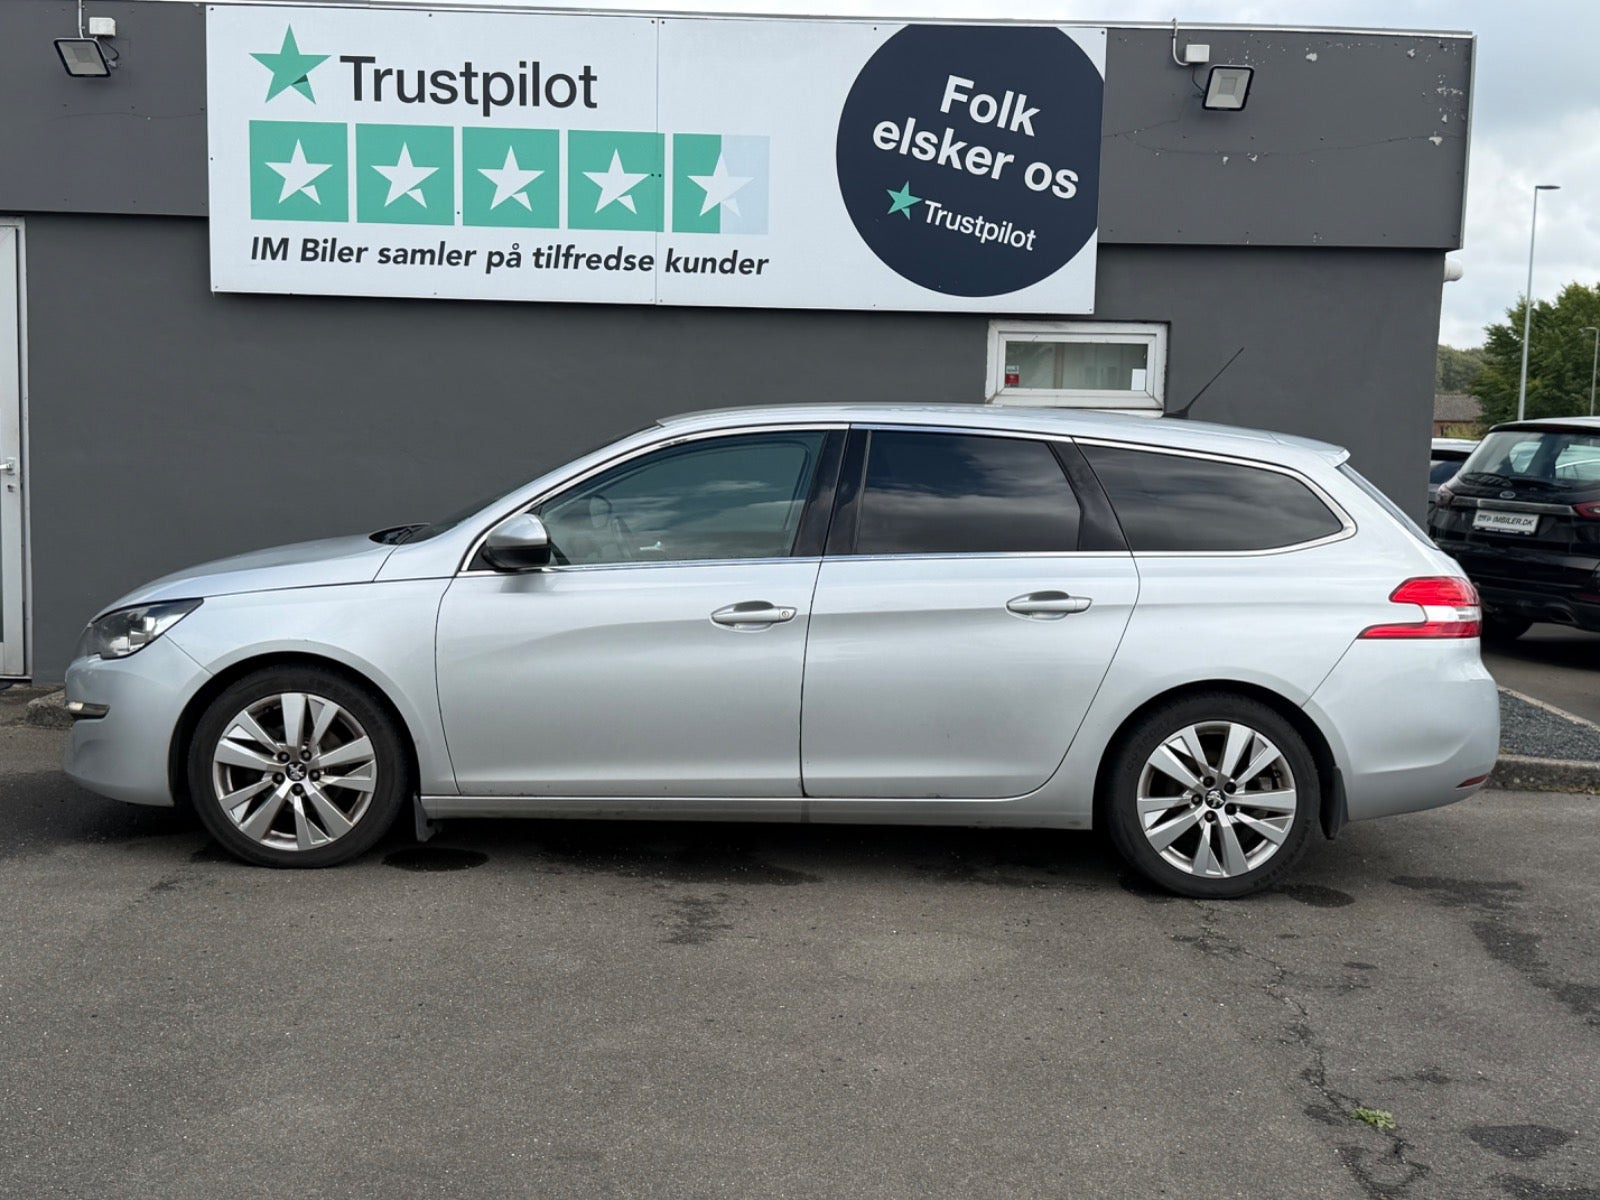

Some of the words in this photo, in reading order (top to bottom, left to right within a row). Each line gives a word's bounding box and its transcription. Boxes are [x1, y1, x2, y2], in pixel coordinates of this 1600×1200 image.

[339, 55, 598, 118] Trustpilot
[939, 74, 1041, 137] Folk
[872, 117, 1015, 180] elsker
[1024, 161, 1079, 199] os
[251, 236, 290, 261] IM
[300, 238, 369, 263] Biler
[377, 240, 477, 267] samler
[485, 242, 522, 275] på
[532, 244, 655, 272] tilfredse
[665, 247, 770, 275] kunder
[924, 199, 1037, 251] Trustpilot
